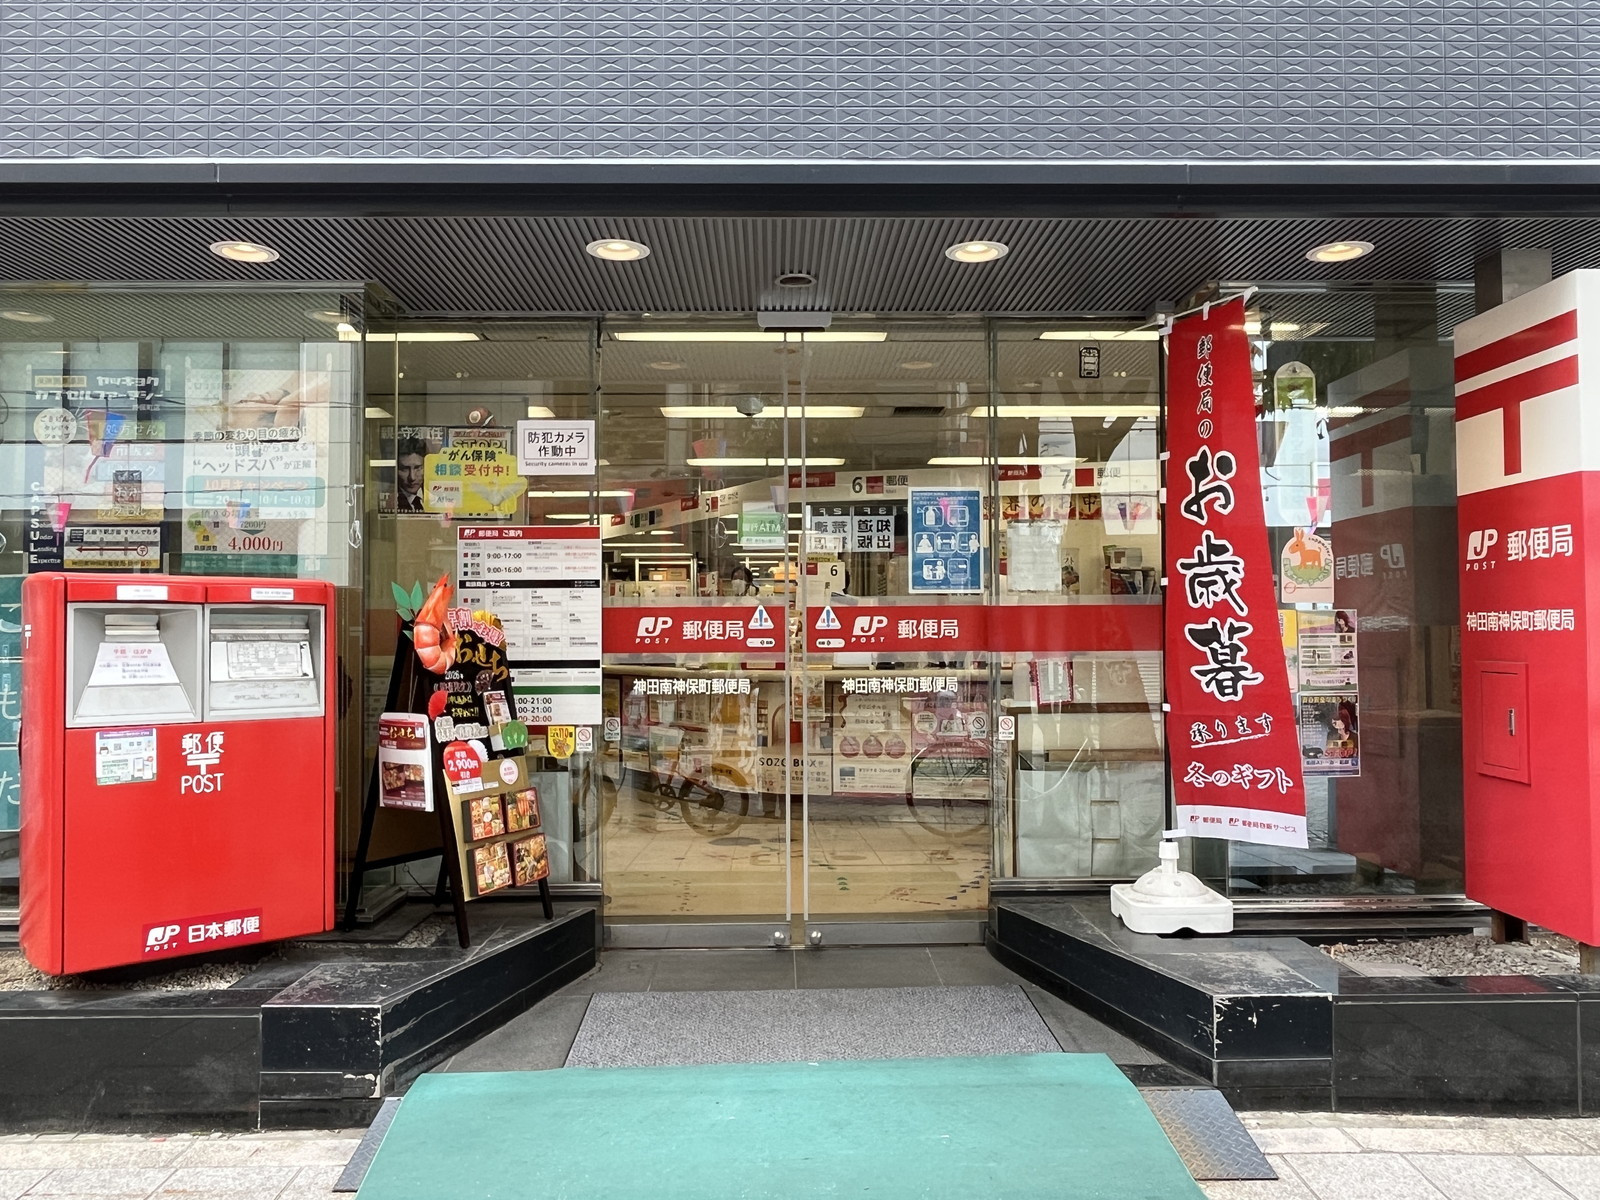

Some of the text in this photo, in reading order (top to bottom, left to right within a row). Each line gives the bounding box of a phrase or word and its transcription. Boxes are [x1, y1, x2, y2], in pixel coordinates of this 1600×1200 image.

[1196, 335, 1213, 439] 郵便局の
[527, 431, 586, 443] 防犯カメラ
[538, 446, 577, 457] 作動中
[852, 475, 909, 494] 6 郵便
[706, 498, 711, 513] 5
[228, 536, 283, 552] 4,000円
[1507, 524, 1573, 562] 郵便局
[829, 565, 838, 576] 6
[1175, 445, 1264, 702] お歳暮
[1466, 560, 1497, 571] POST
[448, 609, 471, 629] 早割
[897, 619, 959, 639] 郵便局
[1466, 609, 1575, 632] 神田南神保町郵便局
[682, 620, 745, 640] 郵便局
[633, 678, 751, 695] 神田南神保町郵便局
[841, 677, 958, 694] 神田南神保町郵便局
[1190, 712, 1273, 744] 承ります
[181, 732, 225, 754] 郵便
[447, 759, 479, 771] 2,900円
[181, 773, 225, 794] POST
[1183, 761, 1294, 794] 冬のギフト
[188, 915, 260, 943] 日本郵便
[145, 942, 179, 953] POST
